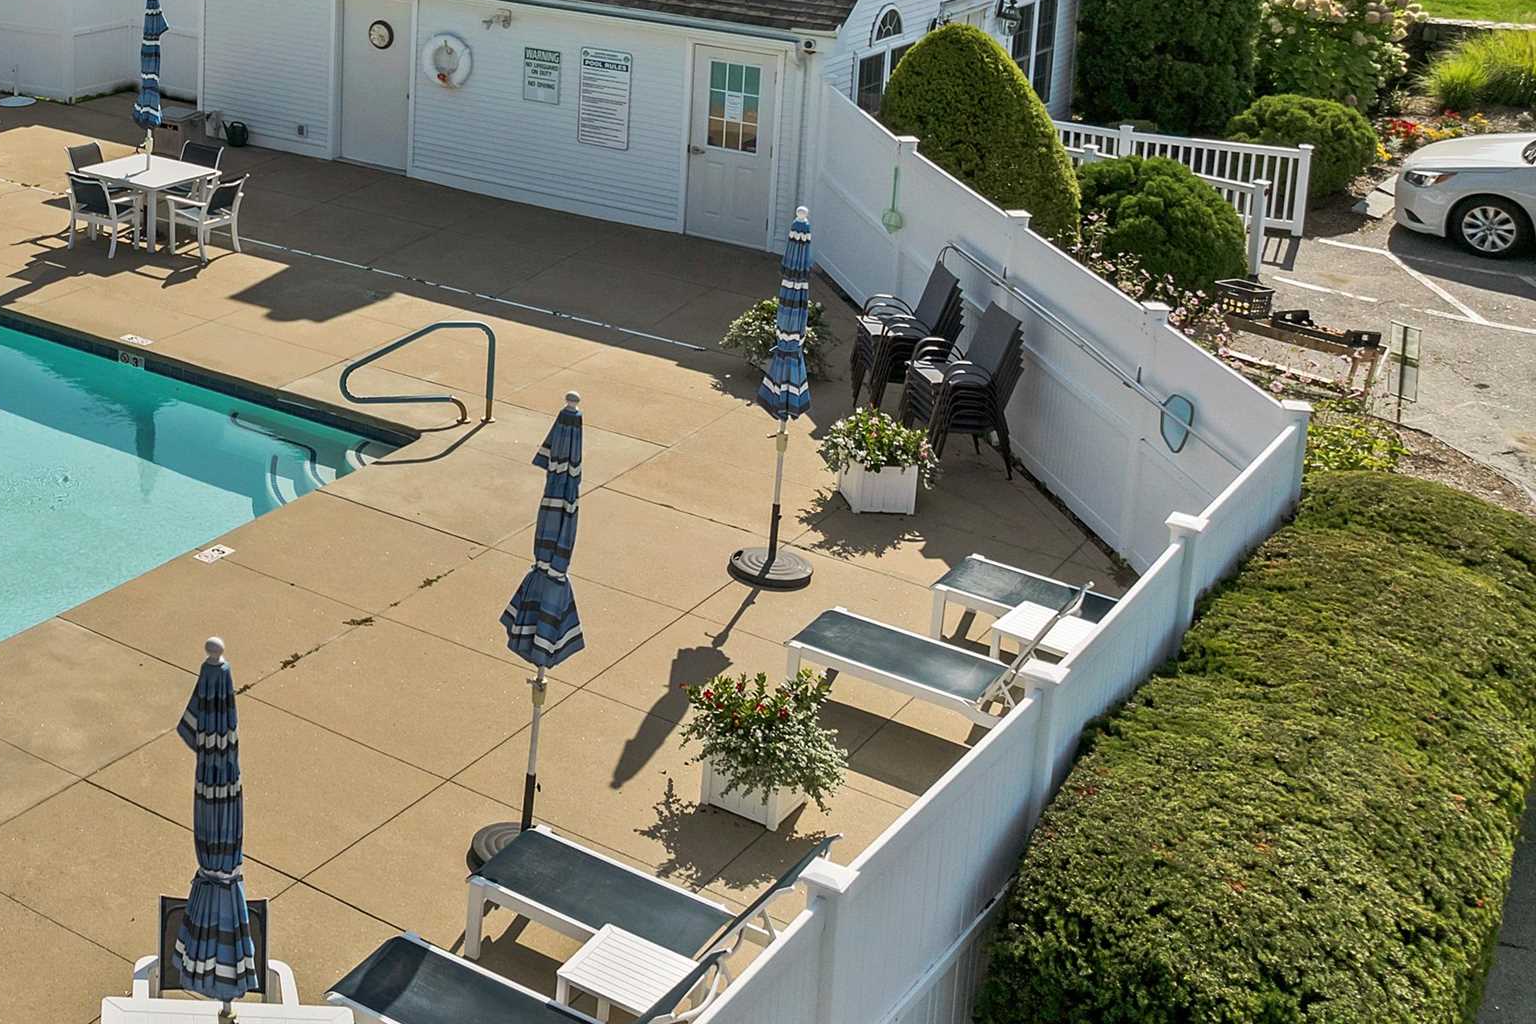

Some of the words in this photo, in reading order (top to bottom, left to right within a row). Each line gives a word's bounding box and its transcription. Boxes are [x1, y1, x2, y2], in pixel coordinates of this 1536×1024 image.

[526, 49, 560, 63] WARNING
[534, 63, 558, 71] LIFEGUARD
[584, 60, 603, 68] POOL
[604, 62, 627, 71] RULES
[537, 81, 555, 90] DIVING
